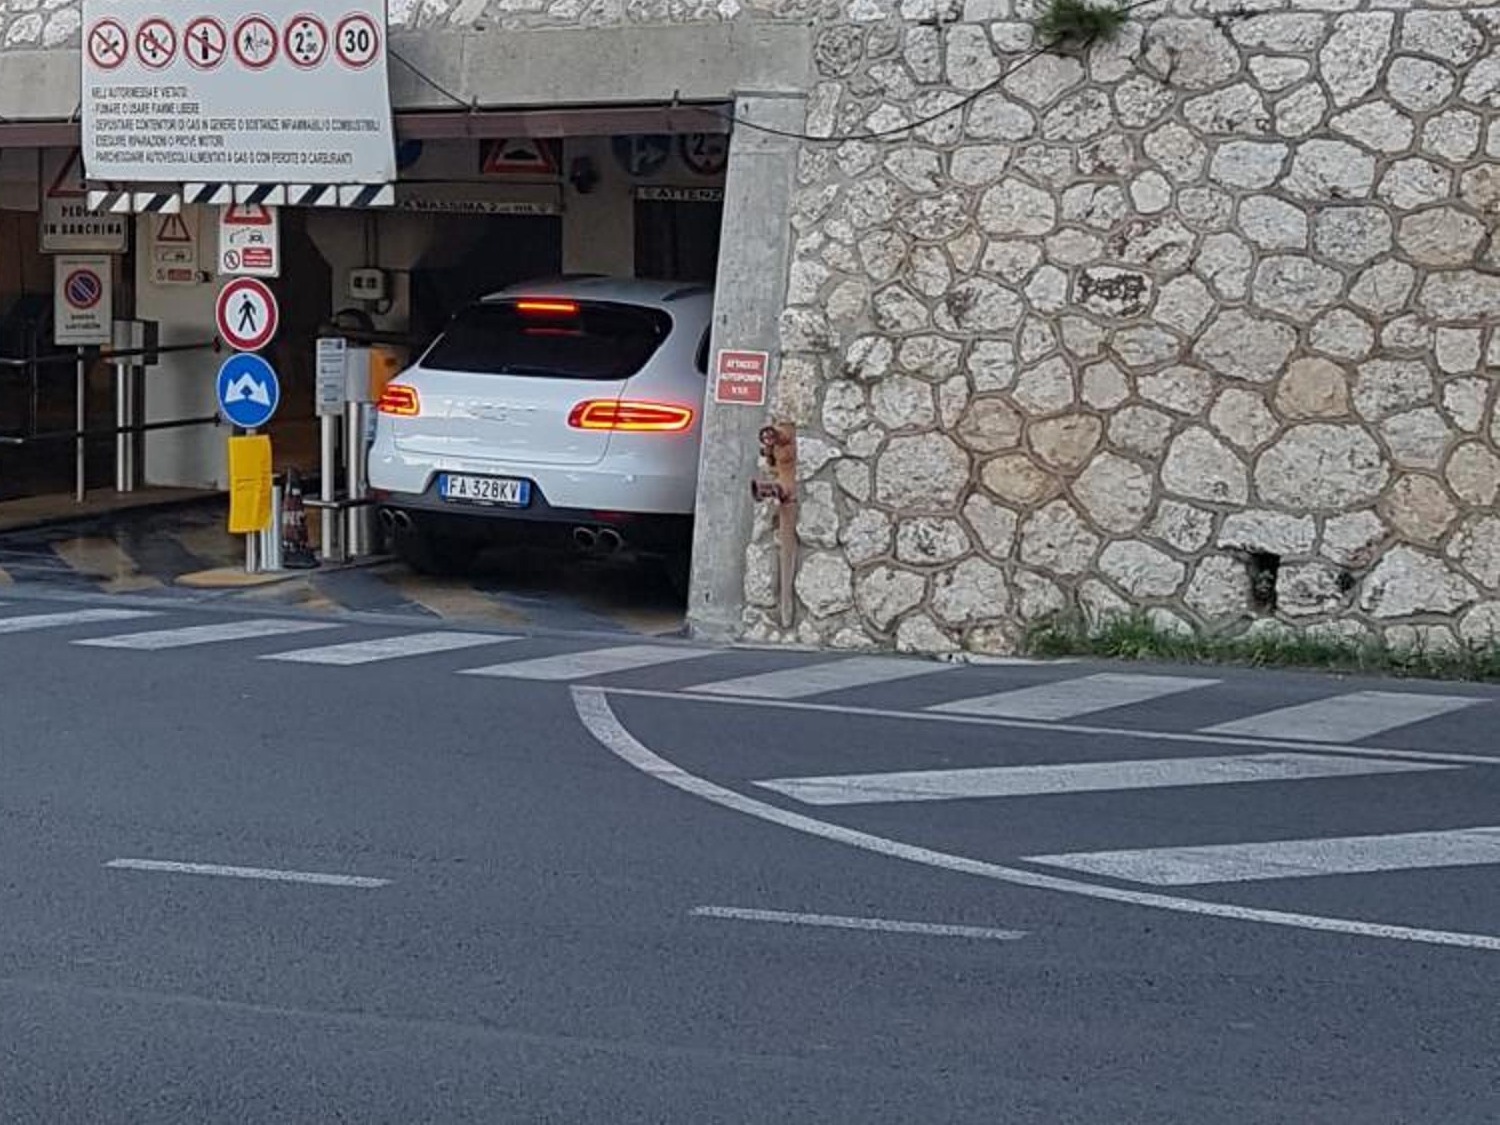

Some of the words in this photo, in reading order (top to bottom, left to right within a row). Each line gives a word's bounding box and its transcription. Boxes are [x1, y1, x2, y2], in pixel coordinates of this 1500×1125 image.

[345, 30, 369, 53] 30
[185, 119, 200, 131] GAS
[233, 151, 248, 163] GAS
[44, 224, 57, 236] IN
[61, 223, 123, 236] BANCHINA
[449, 475, 467, 496] FA
[472, 479, 518, 500] 328KV
